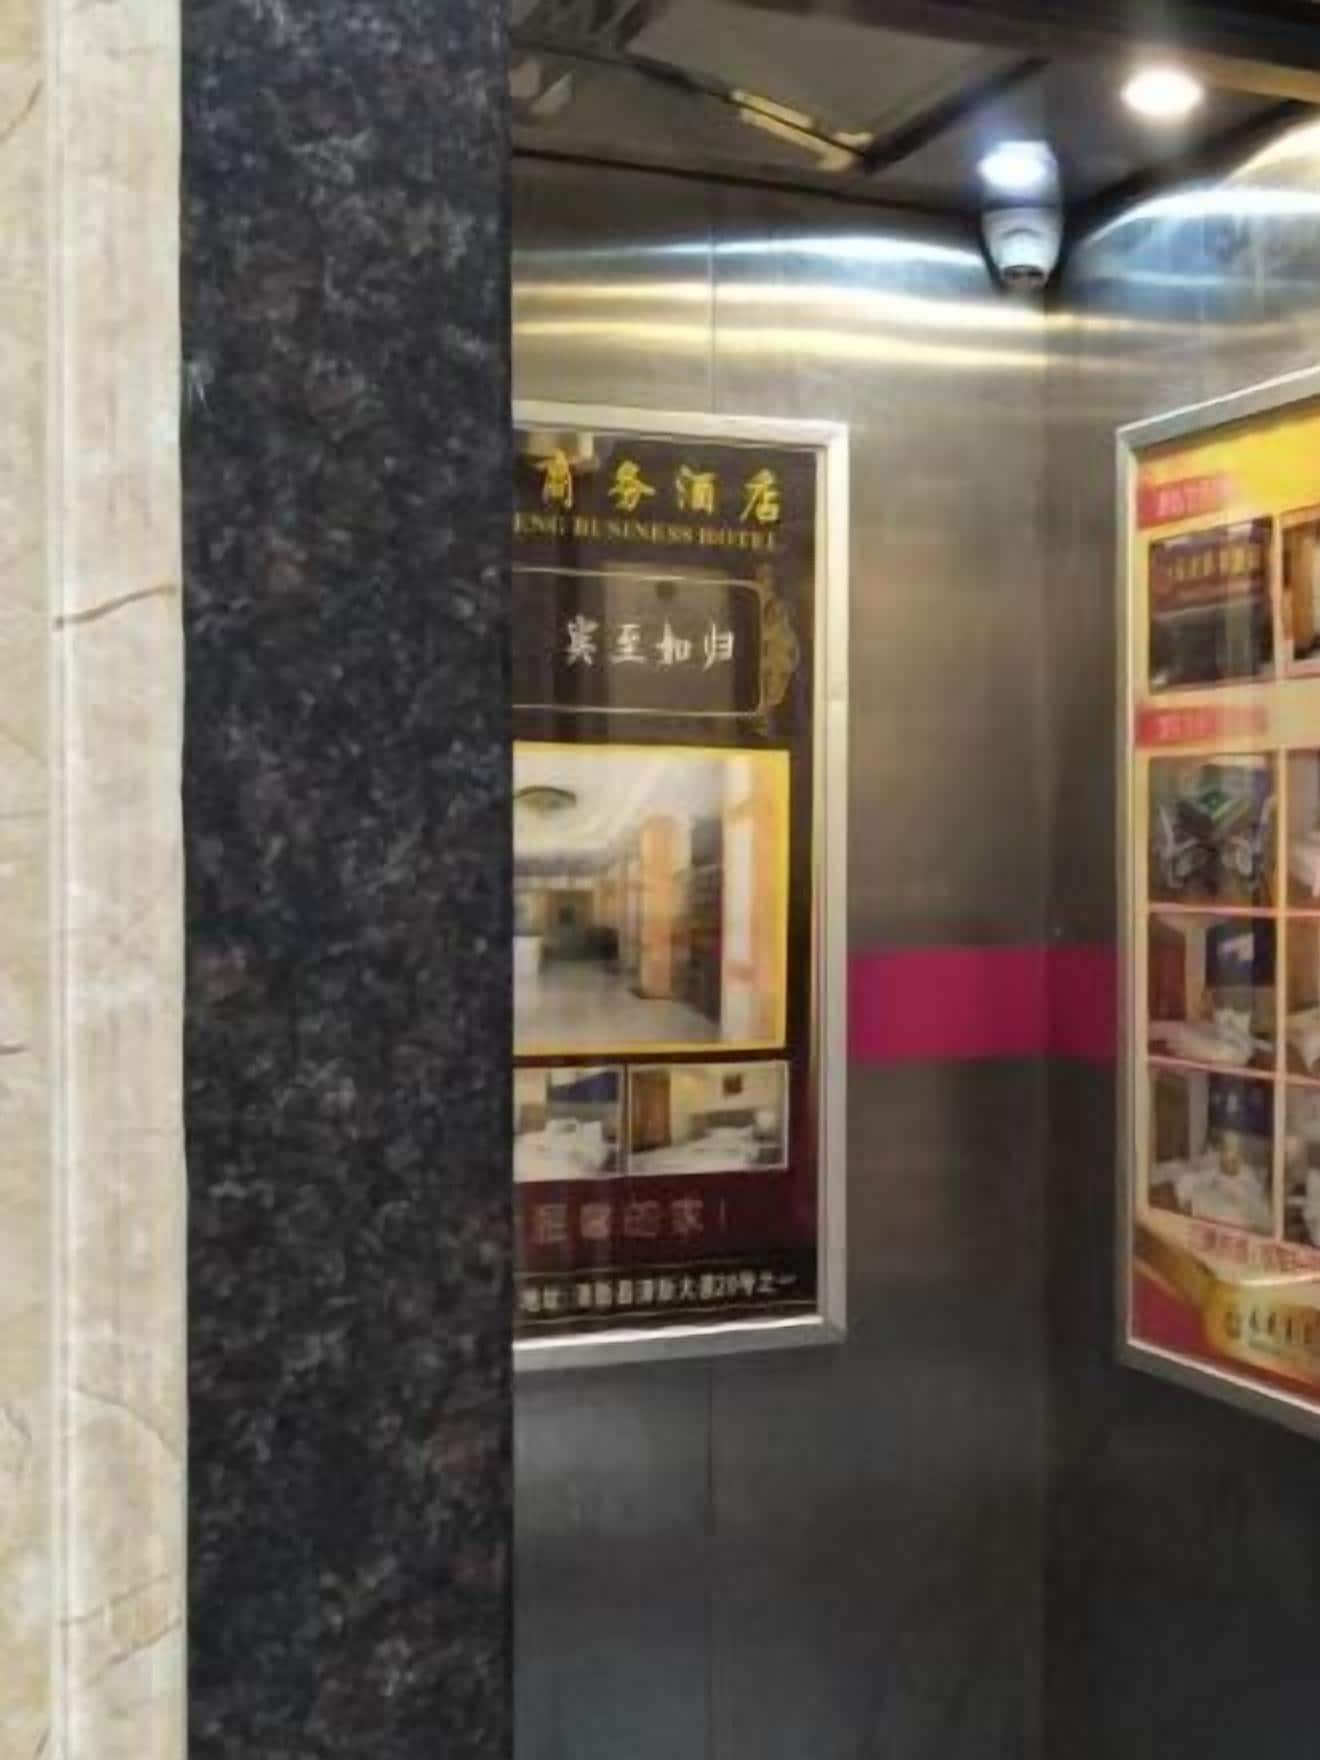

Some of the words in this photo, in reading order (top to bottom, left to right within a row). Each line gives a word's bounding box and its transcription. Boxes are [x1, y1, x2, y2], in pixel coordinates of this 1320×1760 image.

[536, 449, 781, 522] 商务酒店
[574, 515, 693, 544] BUSINESS
[699, 527, 776, 550] HOTEL
[566, 614, 735, 669] 宾至如归
